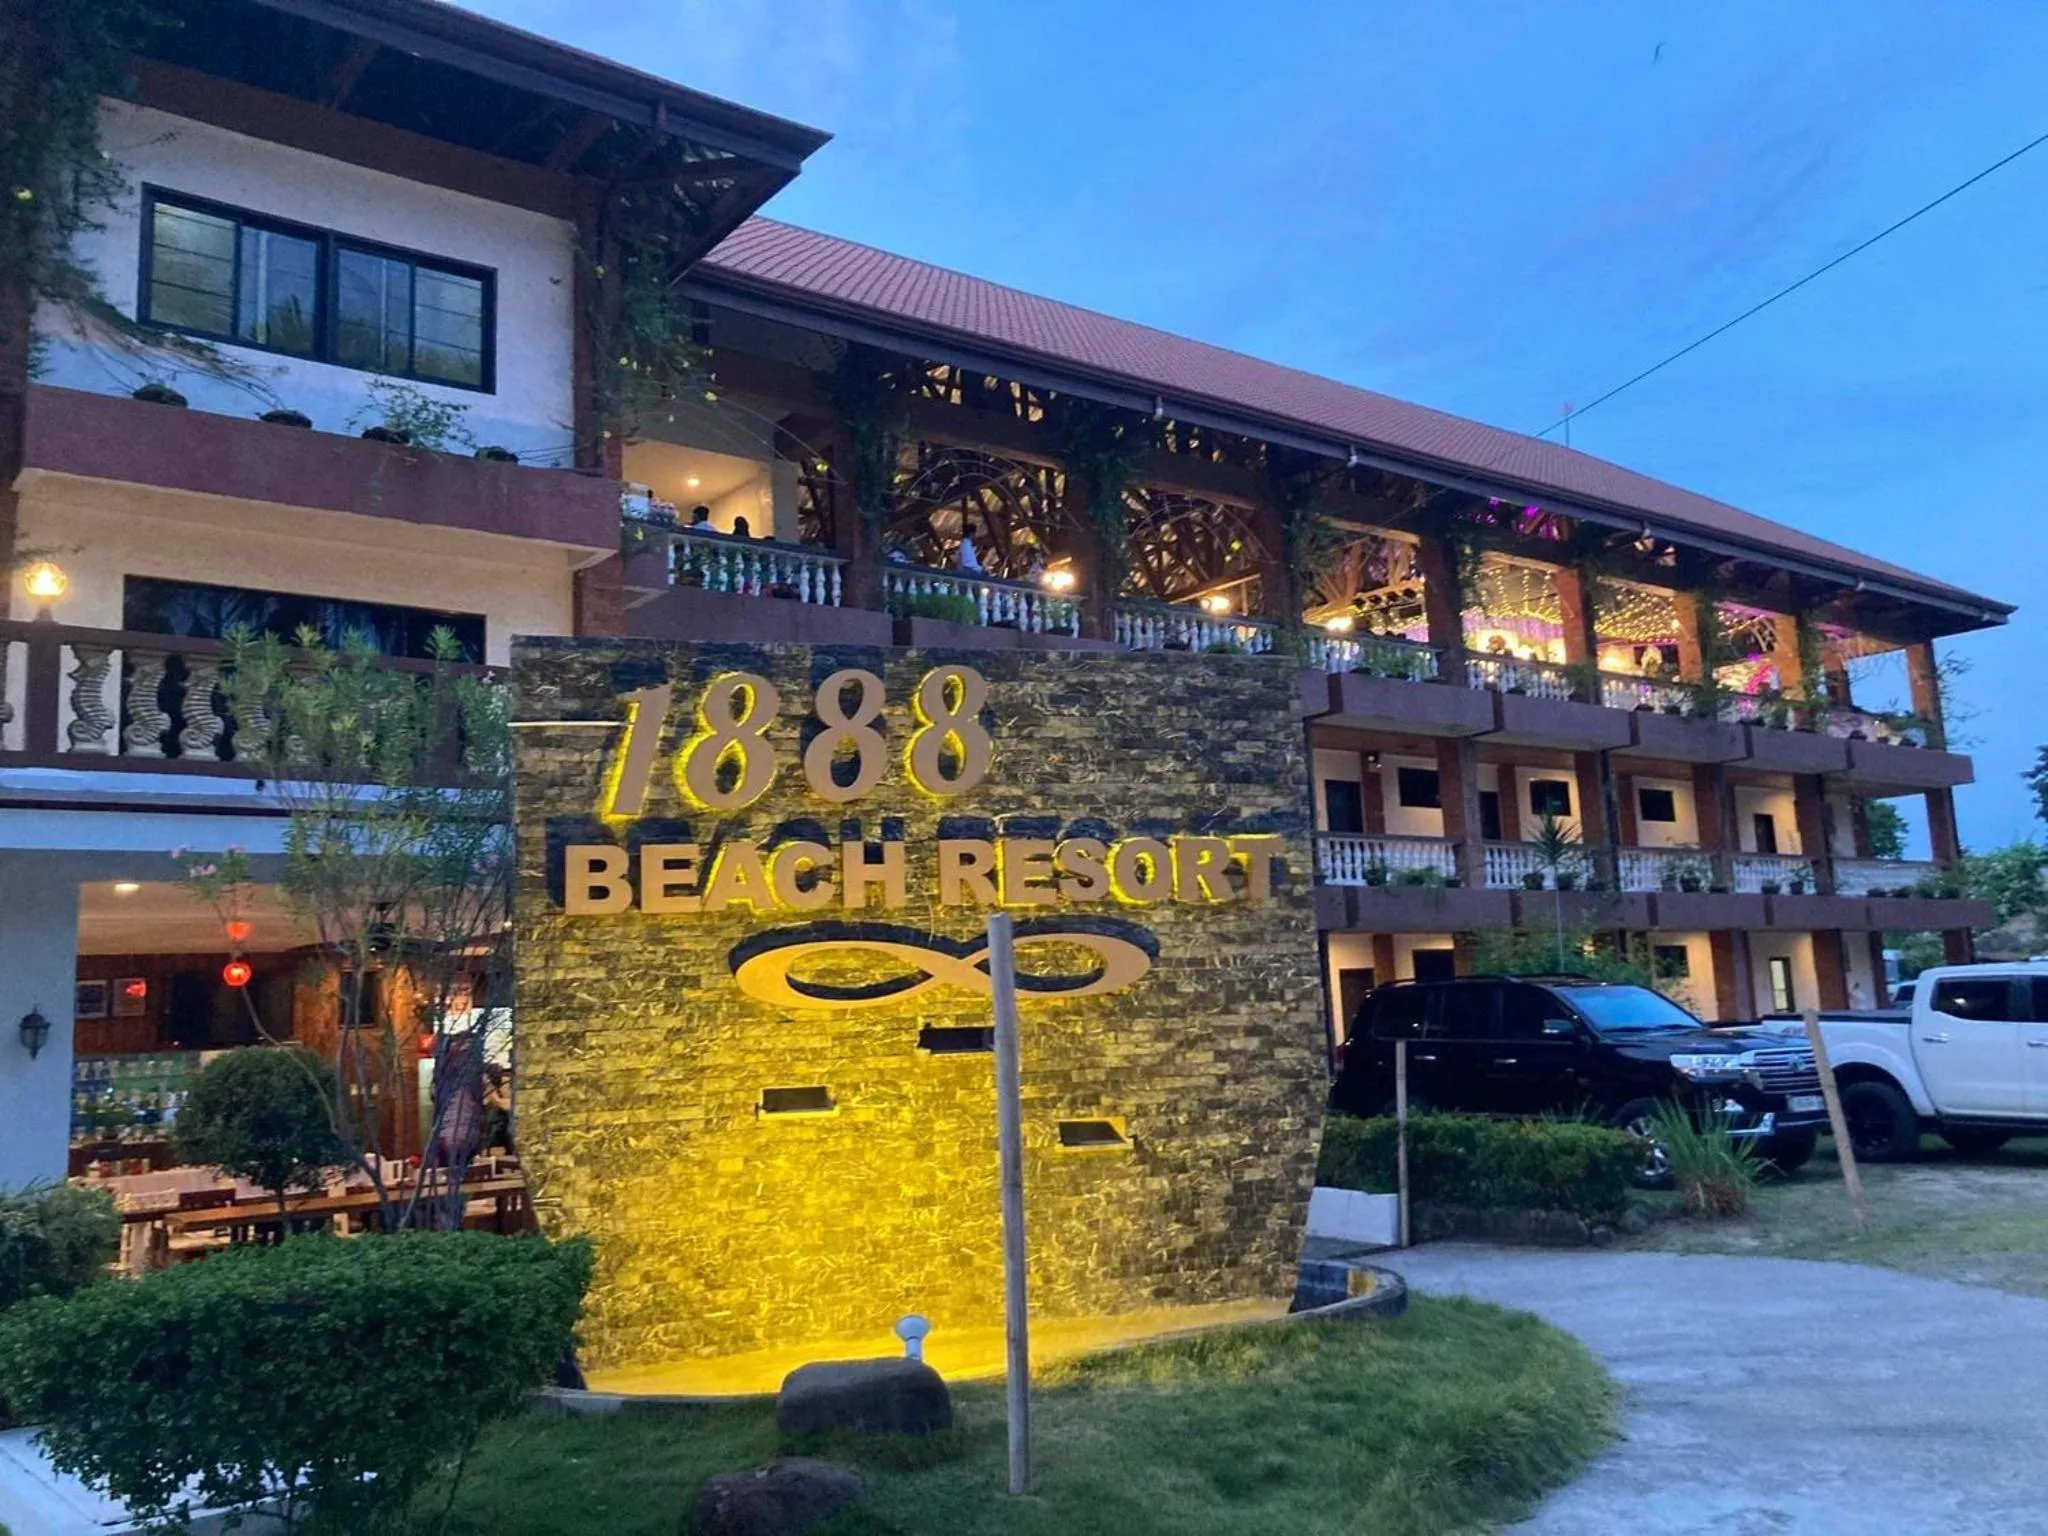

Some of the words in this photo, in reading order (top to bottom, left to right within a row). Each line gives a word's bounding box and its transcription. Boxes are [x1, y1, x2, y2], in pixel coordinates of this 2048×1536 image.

[606, 664, 992, 816] 1888
[564, 841, 905, 914] BEACH
[939, 834, 1280, 906] RESORT
